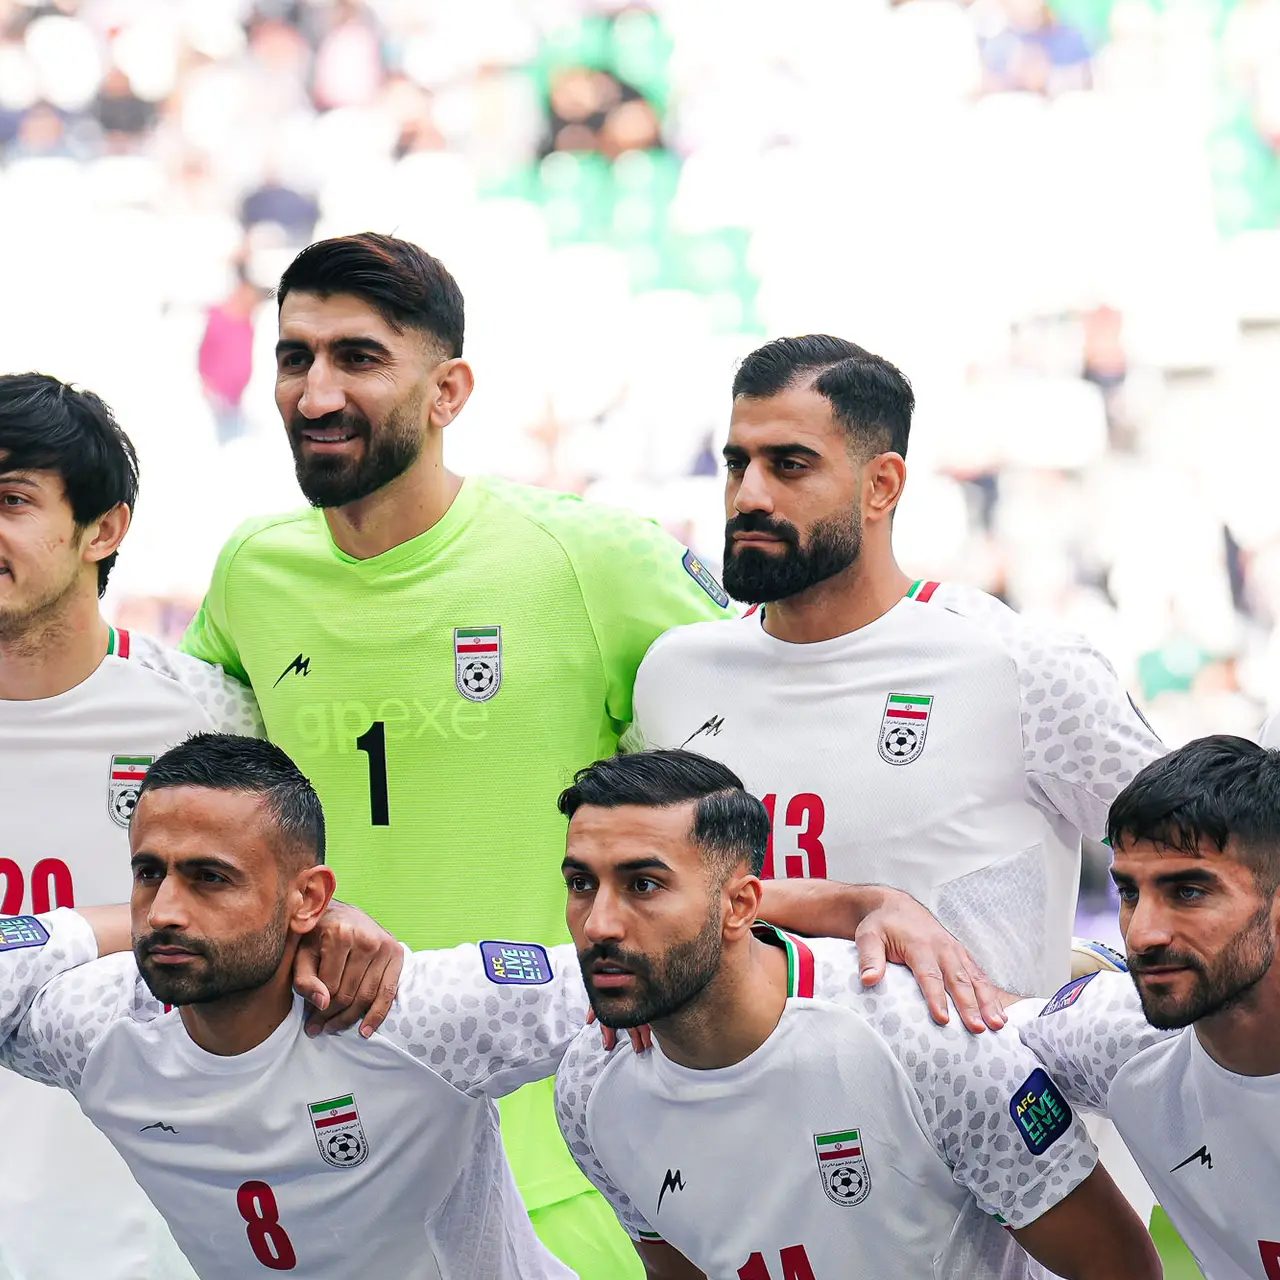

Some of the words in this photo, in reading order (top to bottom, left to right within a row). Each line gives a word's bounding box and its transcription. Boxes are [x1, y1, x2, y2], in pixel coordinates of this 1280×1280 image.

[356, 721, 390, 826] 1
[491, 957, 506, 978] AFC
[500, 948, 525, 979] LIVE
[1016, 1091, 1037, 1117] AFC
[1020, 1089, 1056, 1132] LIVE
[236, 1180, 297, 1270] 8
